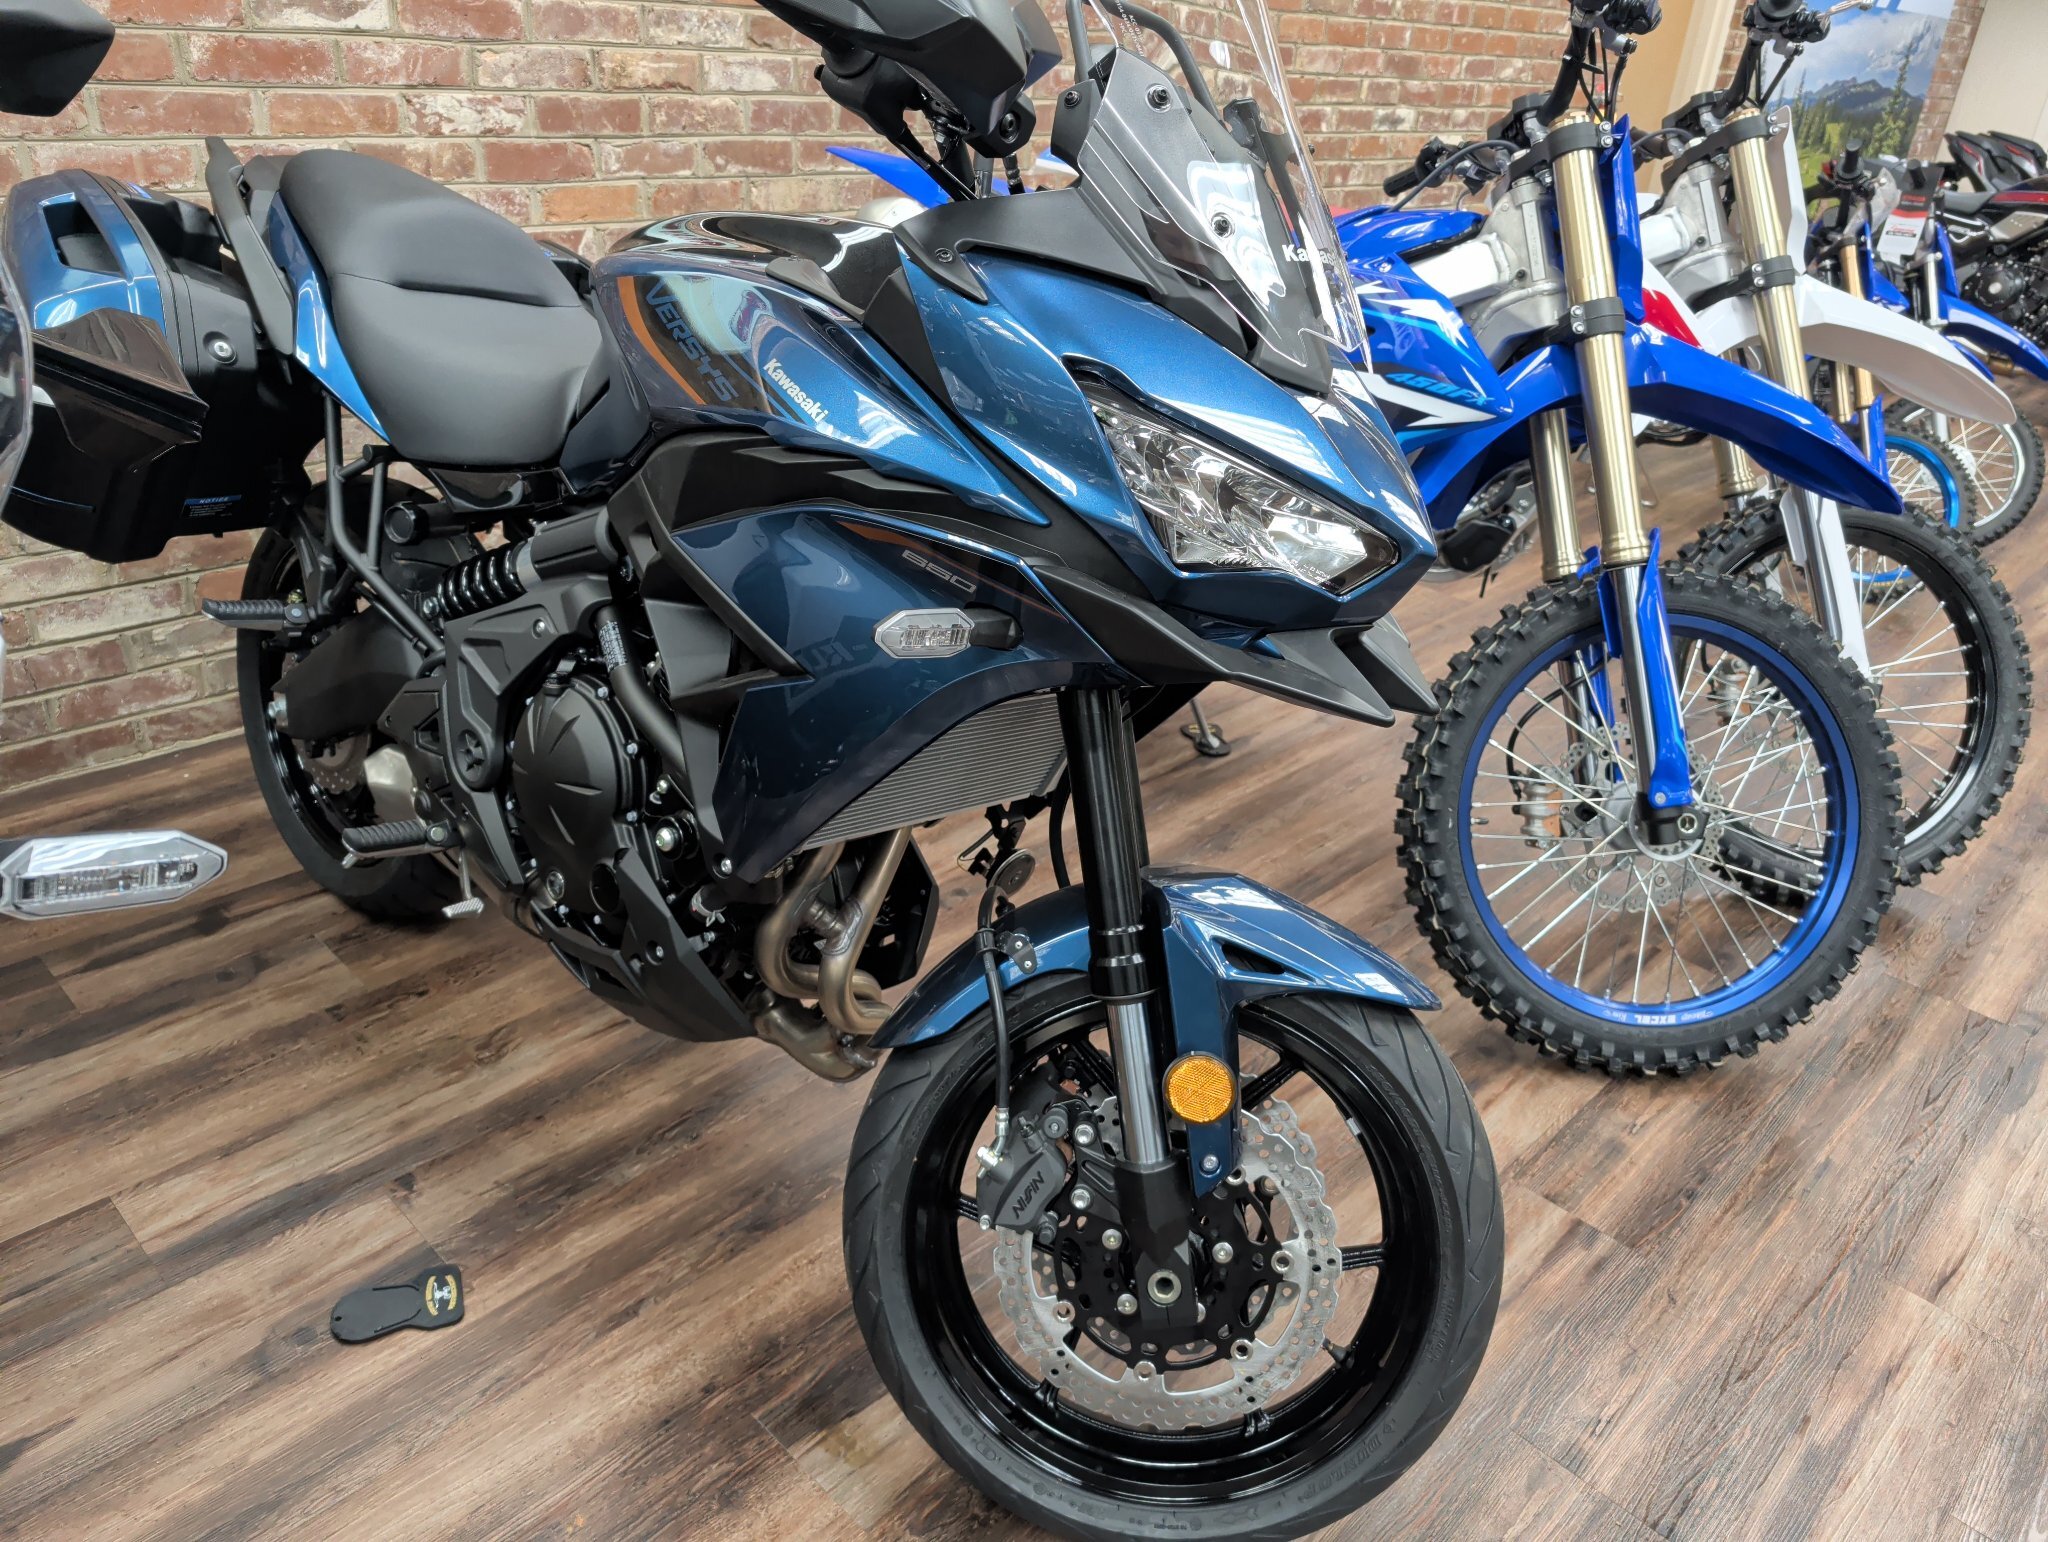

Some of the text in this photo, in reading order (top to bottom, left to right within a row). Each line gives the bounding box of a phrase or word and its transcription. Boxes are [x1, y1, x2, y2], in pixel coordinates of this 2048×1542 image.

[646, 280, 740, 401] VERSYS
[763, 358, 829, 423] Kawasaki
[902, 549, 977, 593] 650
[1634, 1013, 1677, 1025] EXCEL
